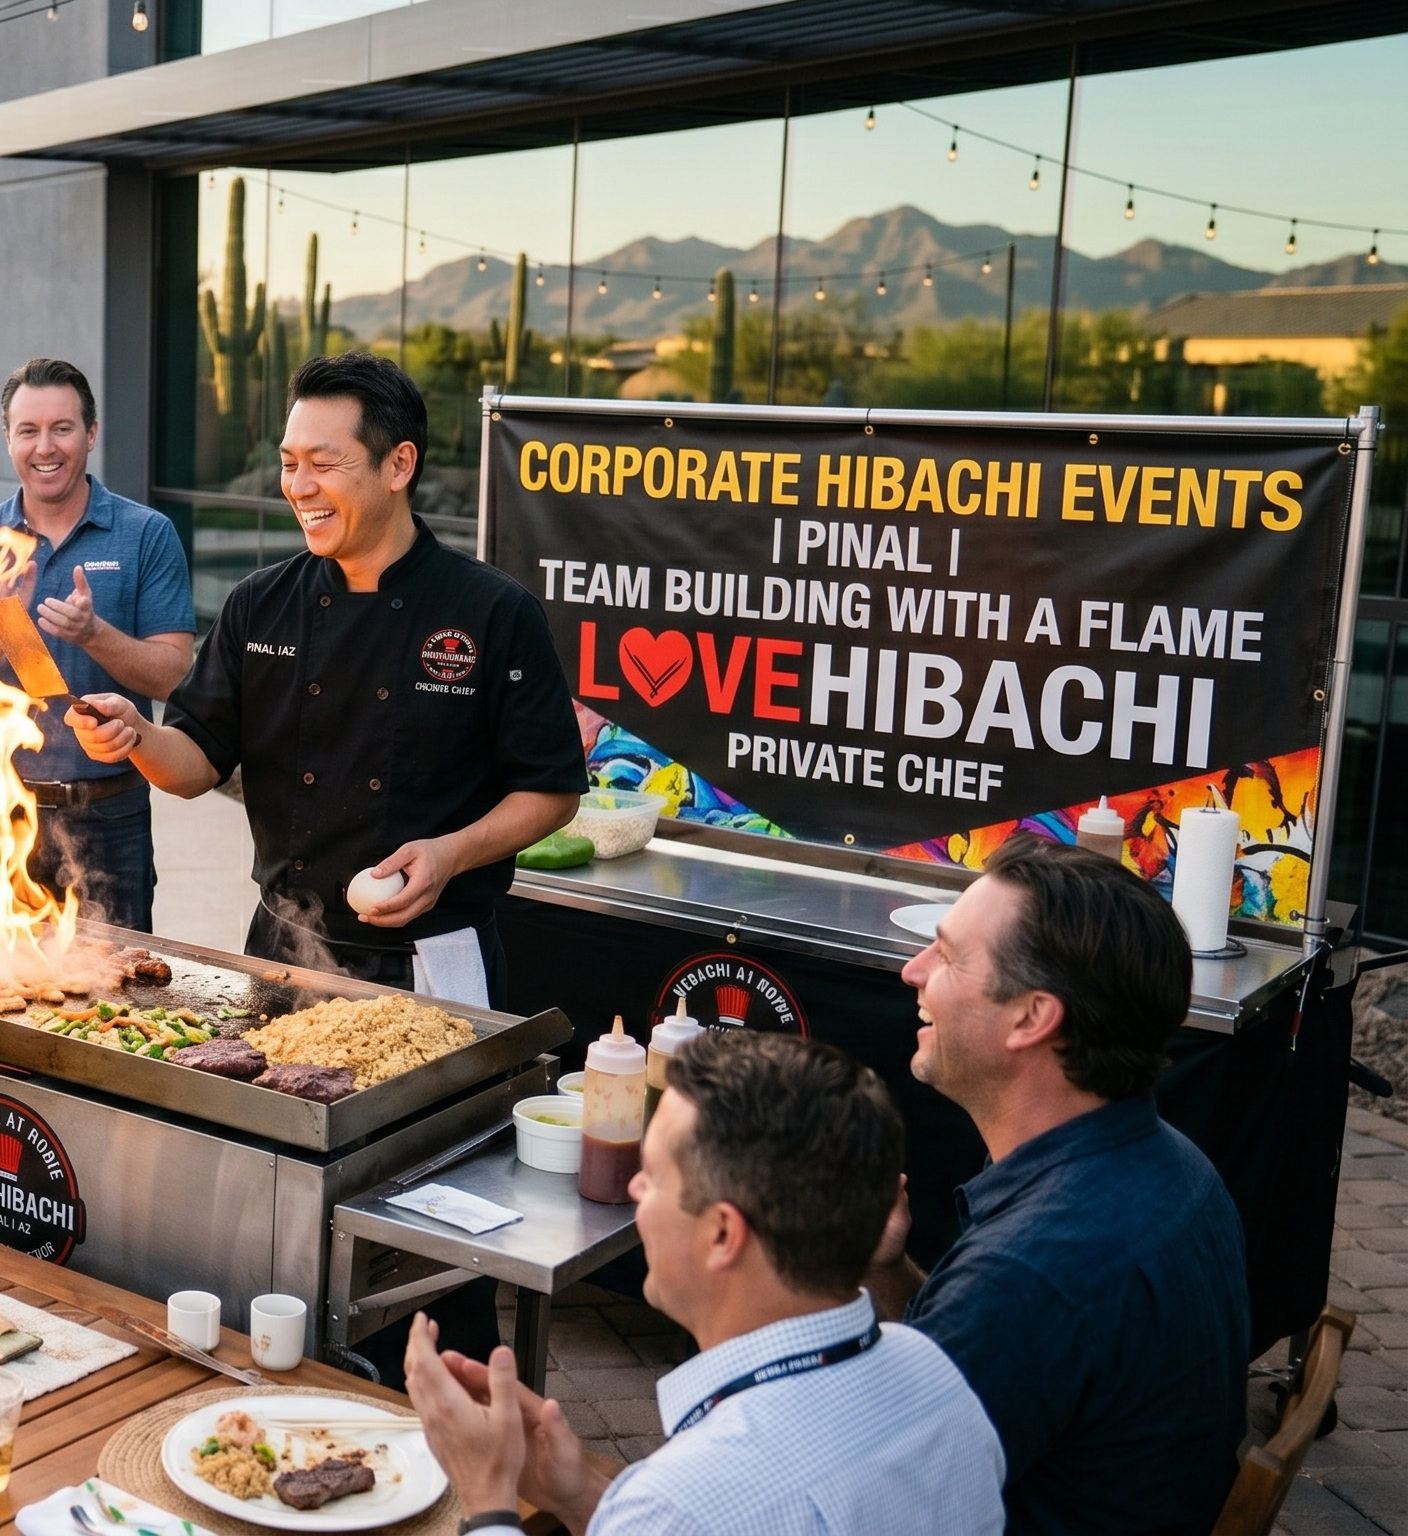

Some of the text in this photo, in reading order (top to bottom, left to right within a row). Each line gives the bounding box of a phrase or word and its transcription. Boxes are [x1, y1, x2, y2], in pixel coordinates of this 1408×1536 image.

[519, 440, 1303, 532] CORPORATE HIBACHI EVENTS
[797, 519, 932, 573] PINAL
[539, 558, 1264, 662] TEAM BUILDING WITH A FLAME
[727, 732, 1004, 802] PRIVATE CHEF
